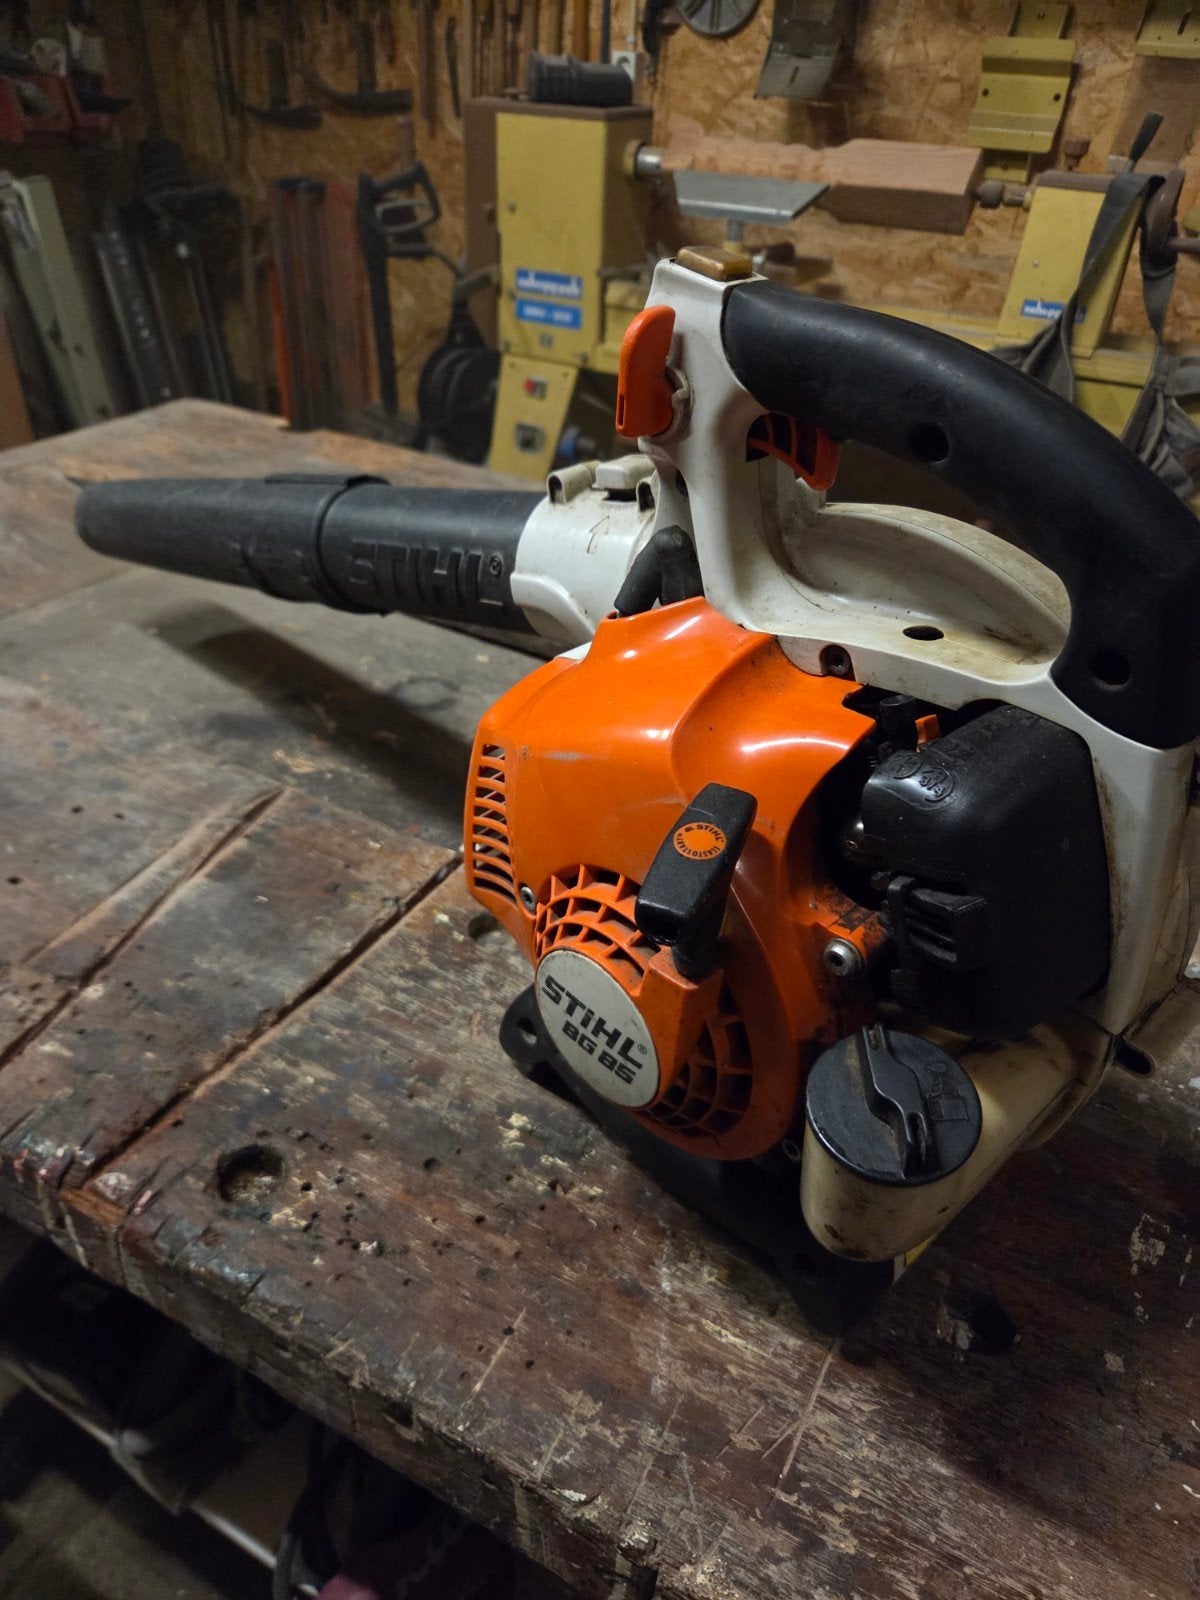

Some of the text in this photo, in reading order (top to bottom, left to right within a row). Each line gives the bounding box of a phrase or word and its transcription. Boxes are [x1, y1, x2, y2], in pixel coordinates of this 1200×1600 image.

[348, 539, 503, 606] STIHL
[541, 974, 643, 1070] STIHL
[562, 1021, 637, 1085] BG 85
